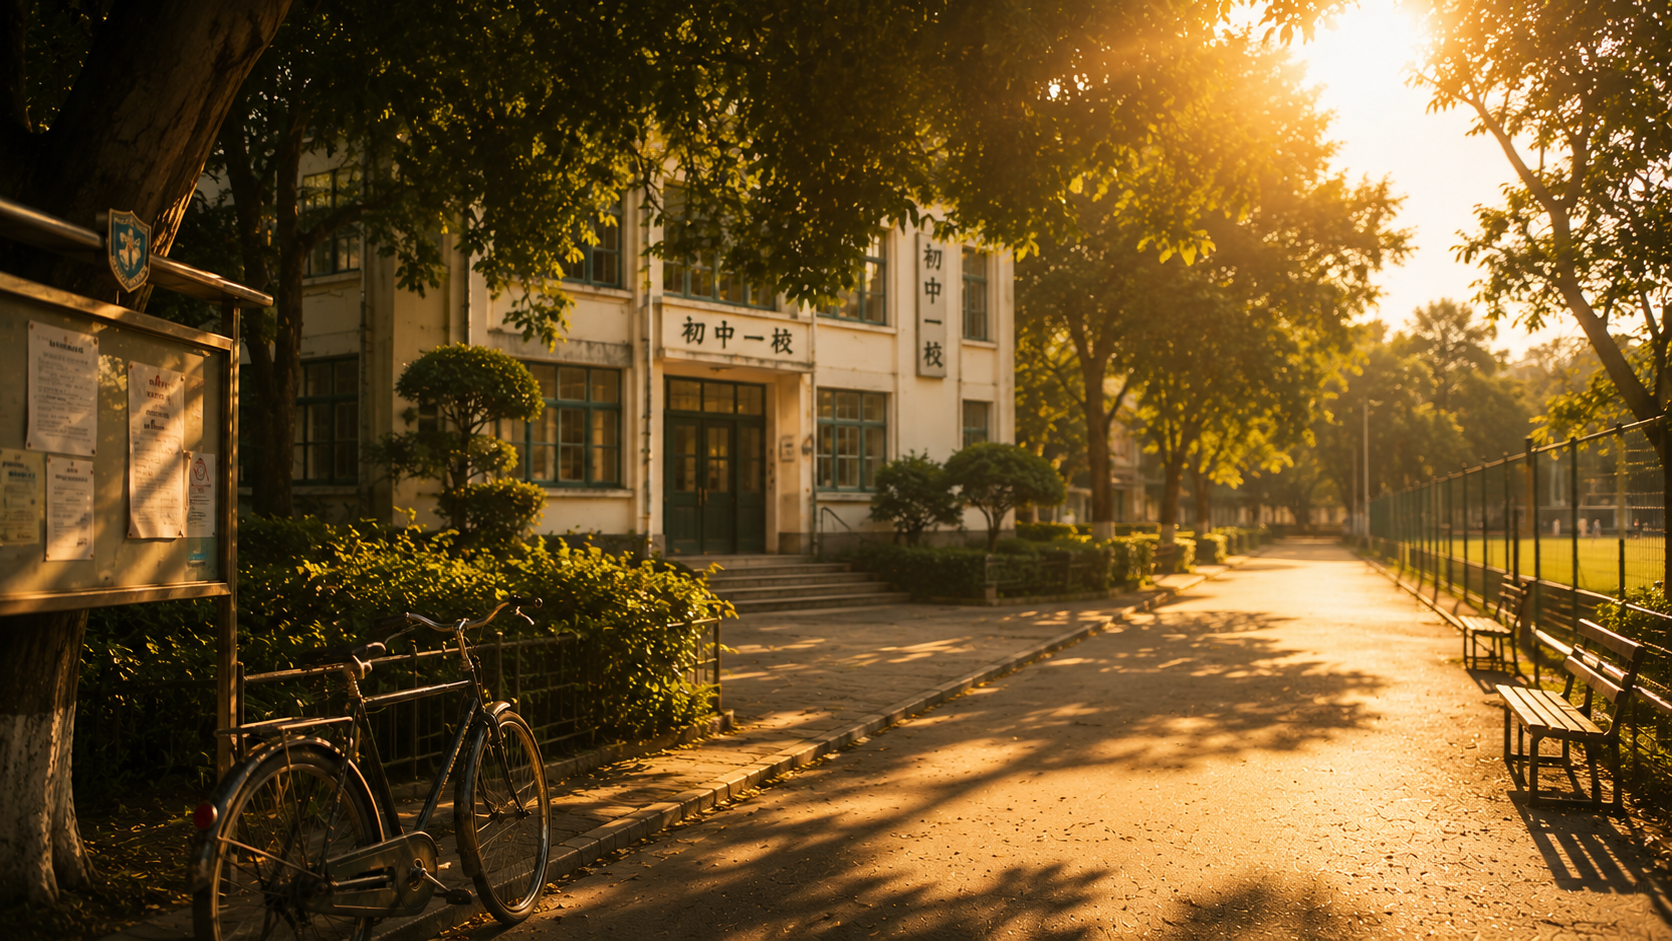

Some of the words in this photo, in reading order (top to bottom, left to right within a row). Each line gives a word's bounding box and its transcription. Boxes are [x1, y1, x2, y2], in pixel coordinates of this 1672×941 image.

[681, 315, 794, 355] 初中一校
[923, 243, 943, 368] 初中一校
